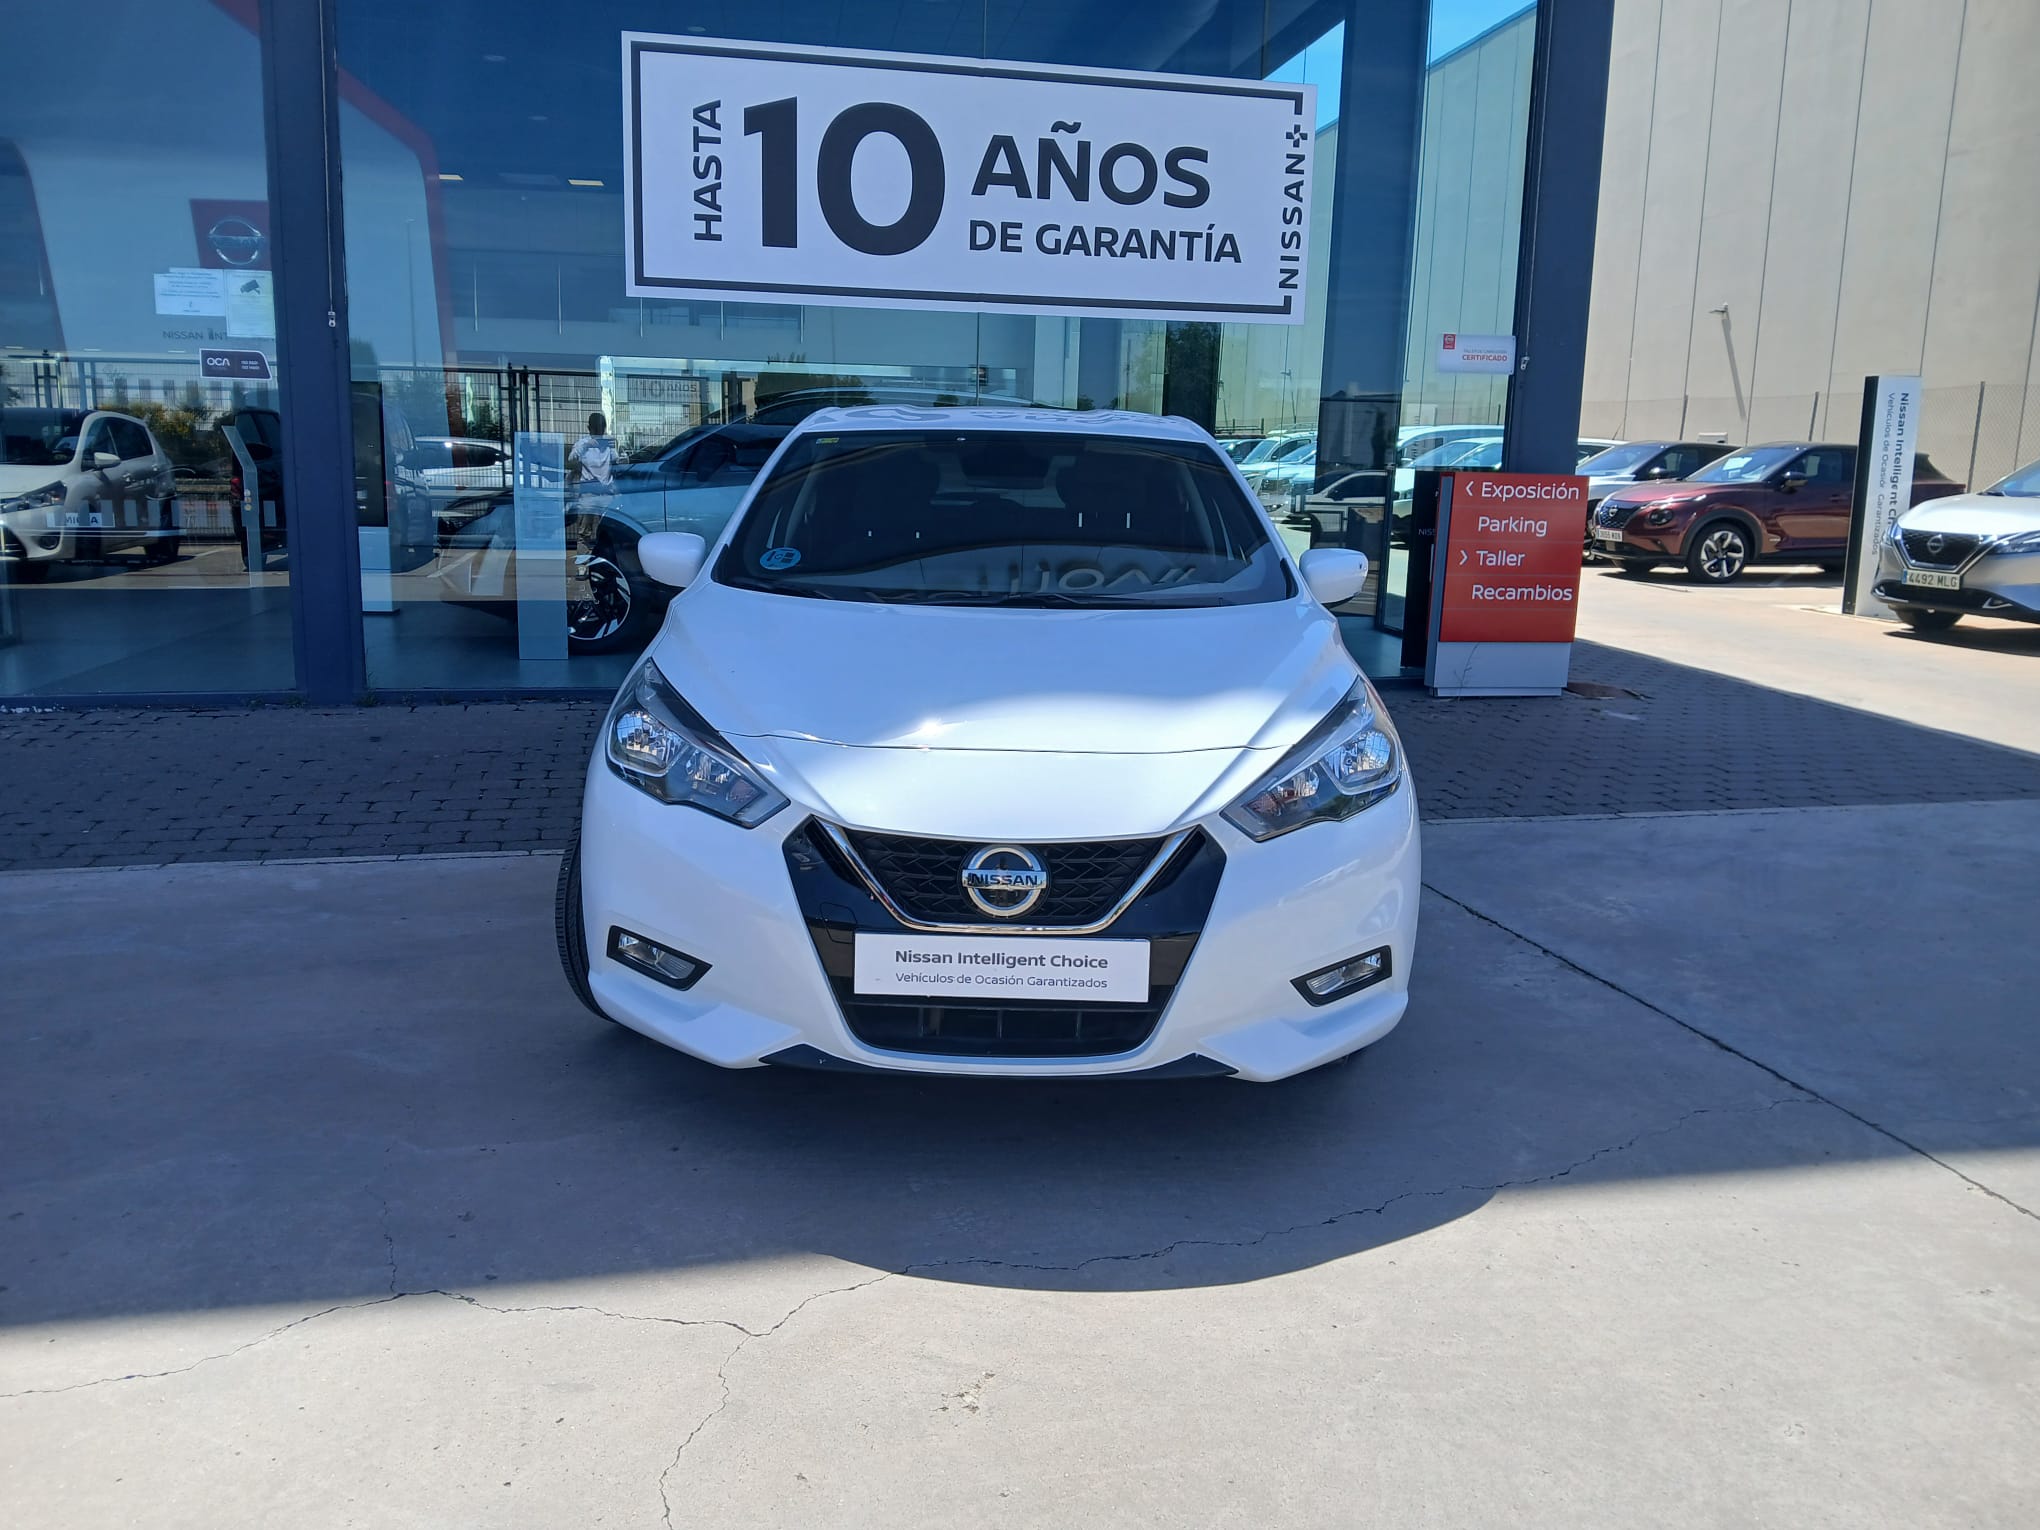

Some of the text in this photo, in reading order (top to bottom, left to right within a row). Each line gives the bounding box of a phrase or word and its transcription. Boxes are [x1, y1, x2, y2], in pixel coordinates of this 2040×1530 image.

[692, 99, 722, 241] HASTA
[743, 96, 1211, 256] 10 AÑOS
[968, 219, 1243, 263] DE GARANTÍA
[1462, 354, 1508, 362] CERTIFICADO
[1884, 393, 1895, 438] Vehículos
[1897, 393, 1909, 436] Nissan
[1882, 440, 1890, 452] de
[1889, 440, 1904, 505] Intelligent
[1480, 482, 1579, 502] Exposición
[1477, 516, 1548, 537] Parking
[1871, 494, 1885, 555] Garantizados
[1476, 550, 1526, 566] Taller
[1908, 573, 1958, 588] 4492 MLG
[1471, 584, 1573, 601] Recambios
[971, 873, 1038, 886] NISSAN
[895, 950, 1109, 969] Nissan Intelligent Choice
[895, 972, 1108, 989] Vehículos de Ocasión Garantizados
